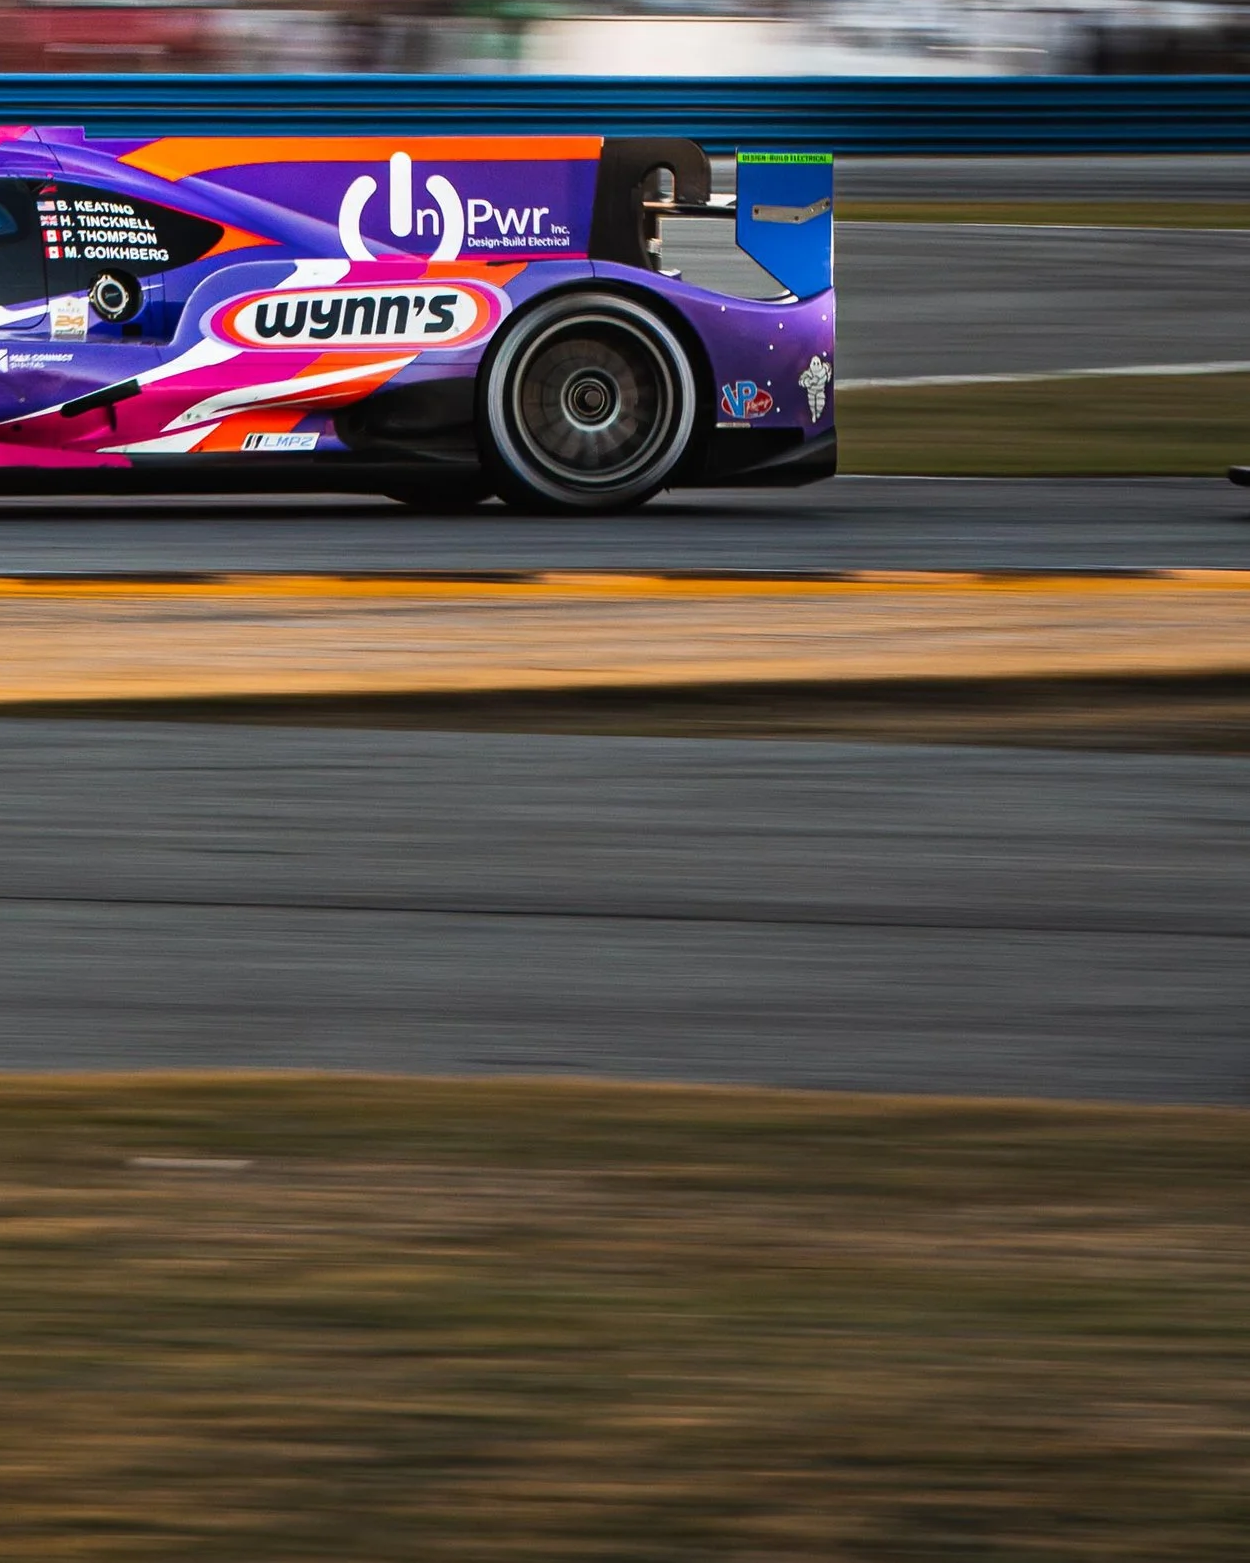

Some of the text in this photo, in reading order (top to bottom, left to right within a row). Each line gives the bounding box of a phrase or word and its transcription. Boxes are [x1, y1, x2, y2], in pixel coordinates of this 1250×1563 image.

[56, 200, 135, 215] B. KEATING
[60, 215, 155, 230] H. TINCKNELL
[551, 224, 570, 234] Inc.
[62, 230, 158, 244] P. THOMPSON
[467, 236, 570, 249] Design-Build Electrical
[65, 246, 170, 261] M. GOIKHBERG
[54, 315, 85, 327] 24
[722, 381, 758, 418] VP
[263, 435, 315, 447] LMP2
